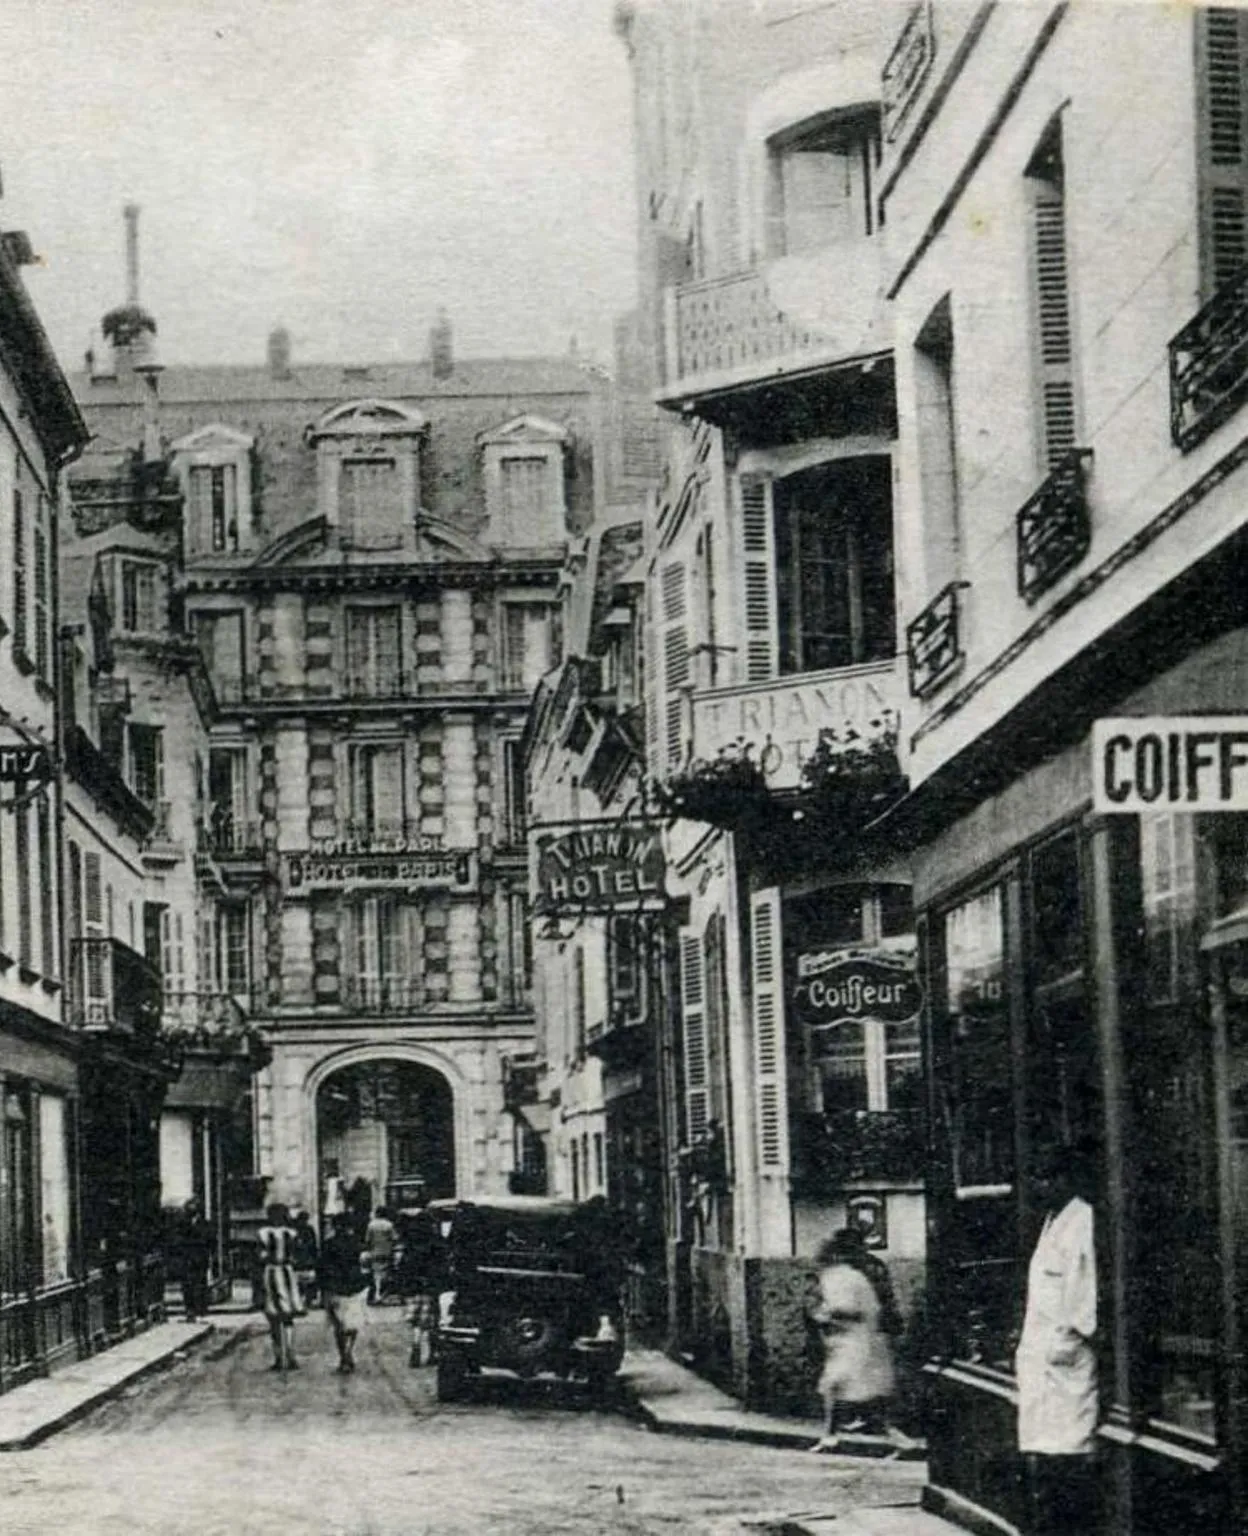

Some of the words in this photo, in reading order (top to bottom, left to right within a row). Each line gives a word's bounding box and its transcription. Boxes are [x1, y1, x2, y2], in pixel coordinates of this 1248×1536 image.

[705, 682, 887, 734] TRIANON
[1104, 732, 1247, 803] COIFF
[311, 839, 368, 854] HOTEL
[396, 837, 452, 852] PARIS
[551, 865, 656, 899] HOTEL
[809, 975, 906, 1013] Coiffeur
